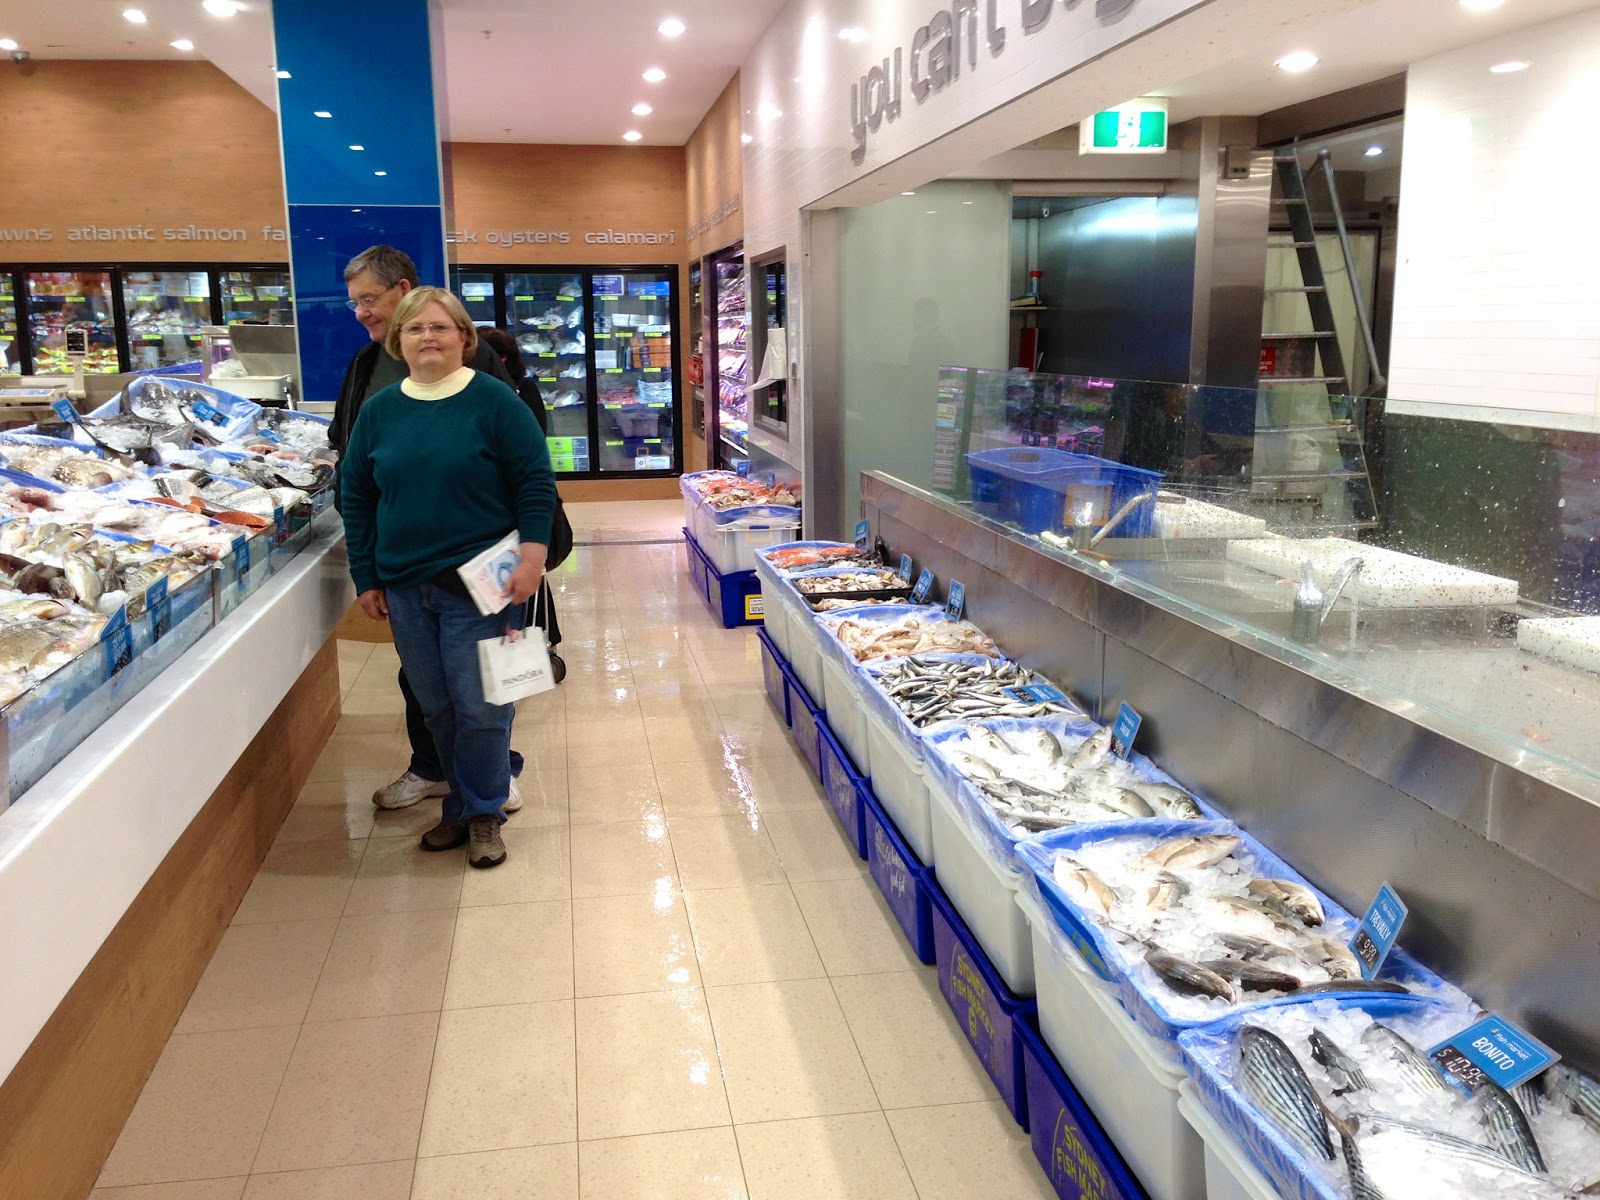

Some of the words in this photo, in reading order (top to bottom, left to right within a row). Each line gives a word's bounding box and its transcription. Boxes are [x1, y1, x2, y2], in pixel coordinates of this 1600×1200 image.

[851, 47, 902, 163] you
[0, 228, 52, 241] wns
[67, 224, 156, 241] atlantic
[163, 225, 247, 241] salmon
[485, 229, 571, 247] oysters
[584, 229, 676, 245] calamari
[502, 669, 544, 687] PANDORA
[1369, 908, 1392, 941] TREVALLY
[1471, 1036, 1515, 1070] BONITO
[1494, 1033, 1508, 1045] fish
[1505, 1042, 1529, 1061] market
[1056, 1147, 1077, 1182] FISH
[1062, 1124, 1106, 1197] SYDNEY
